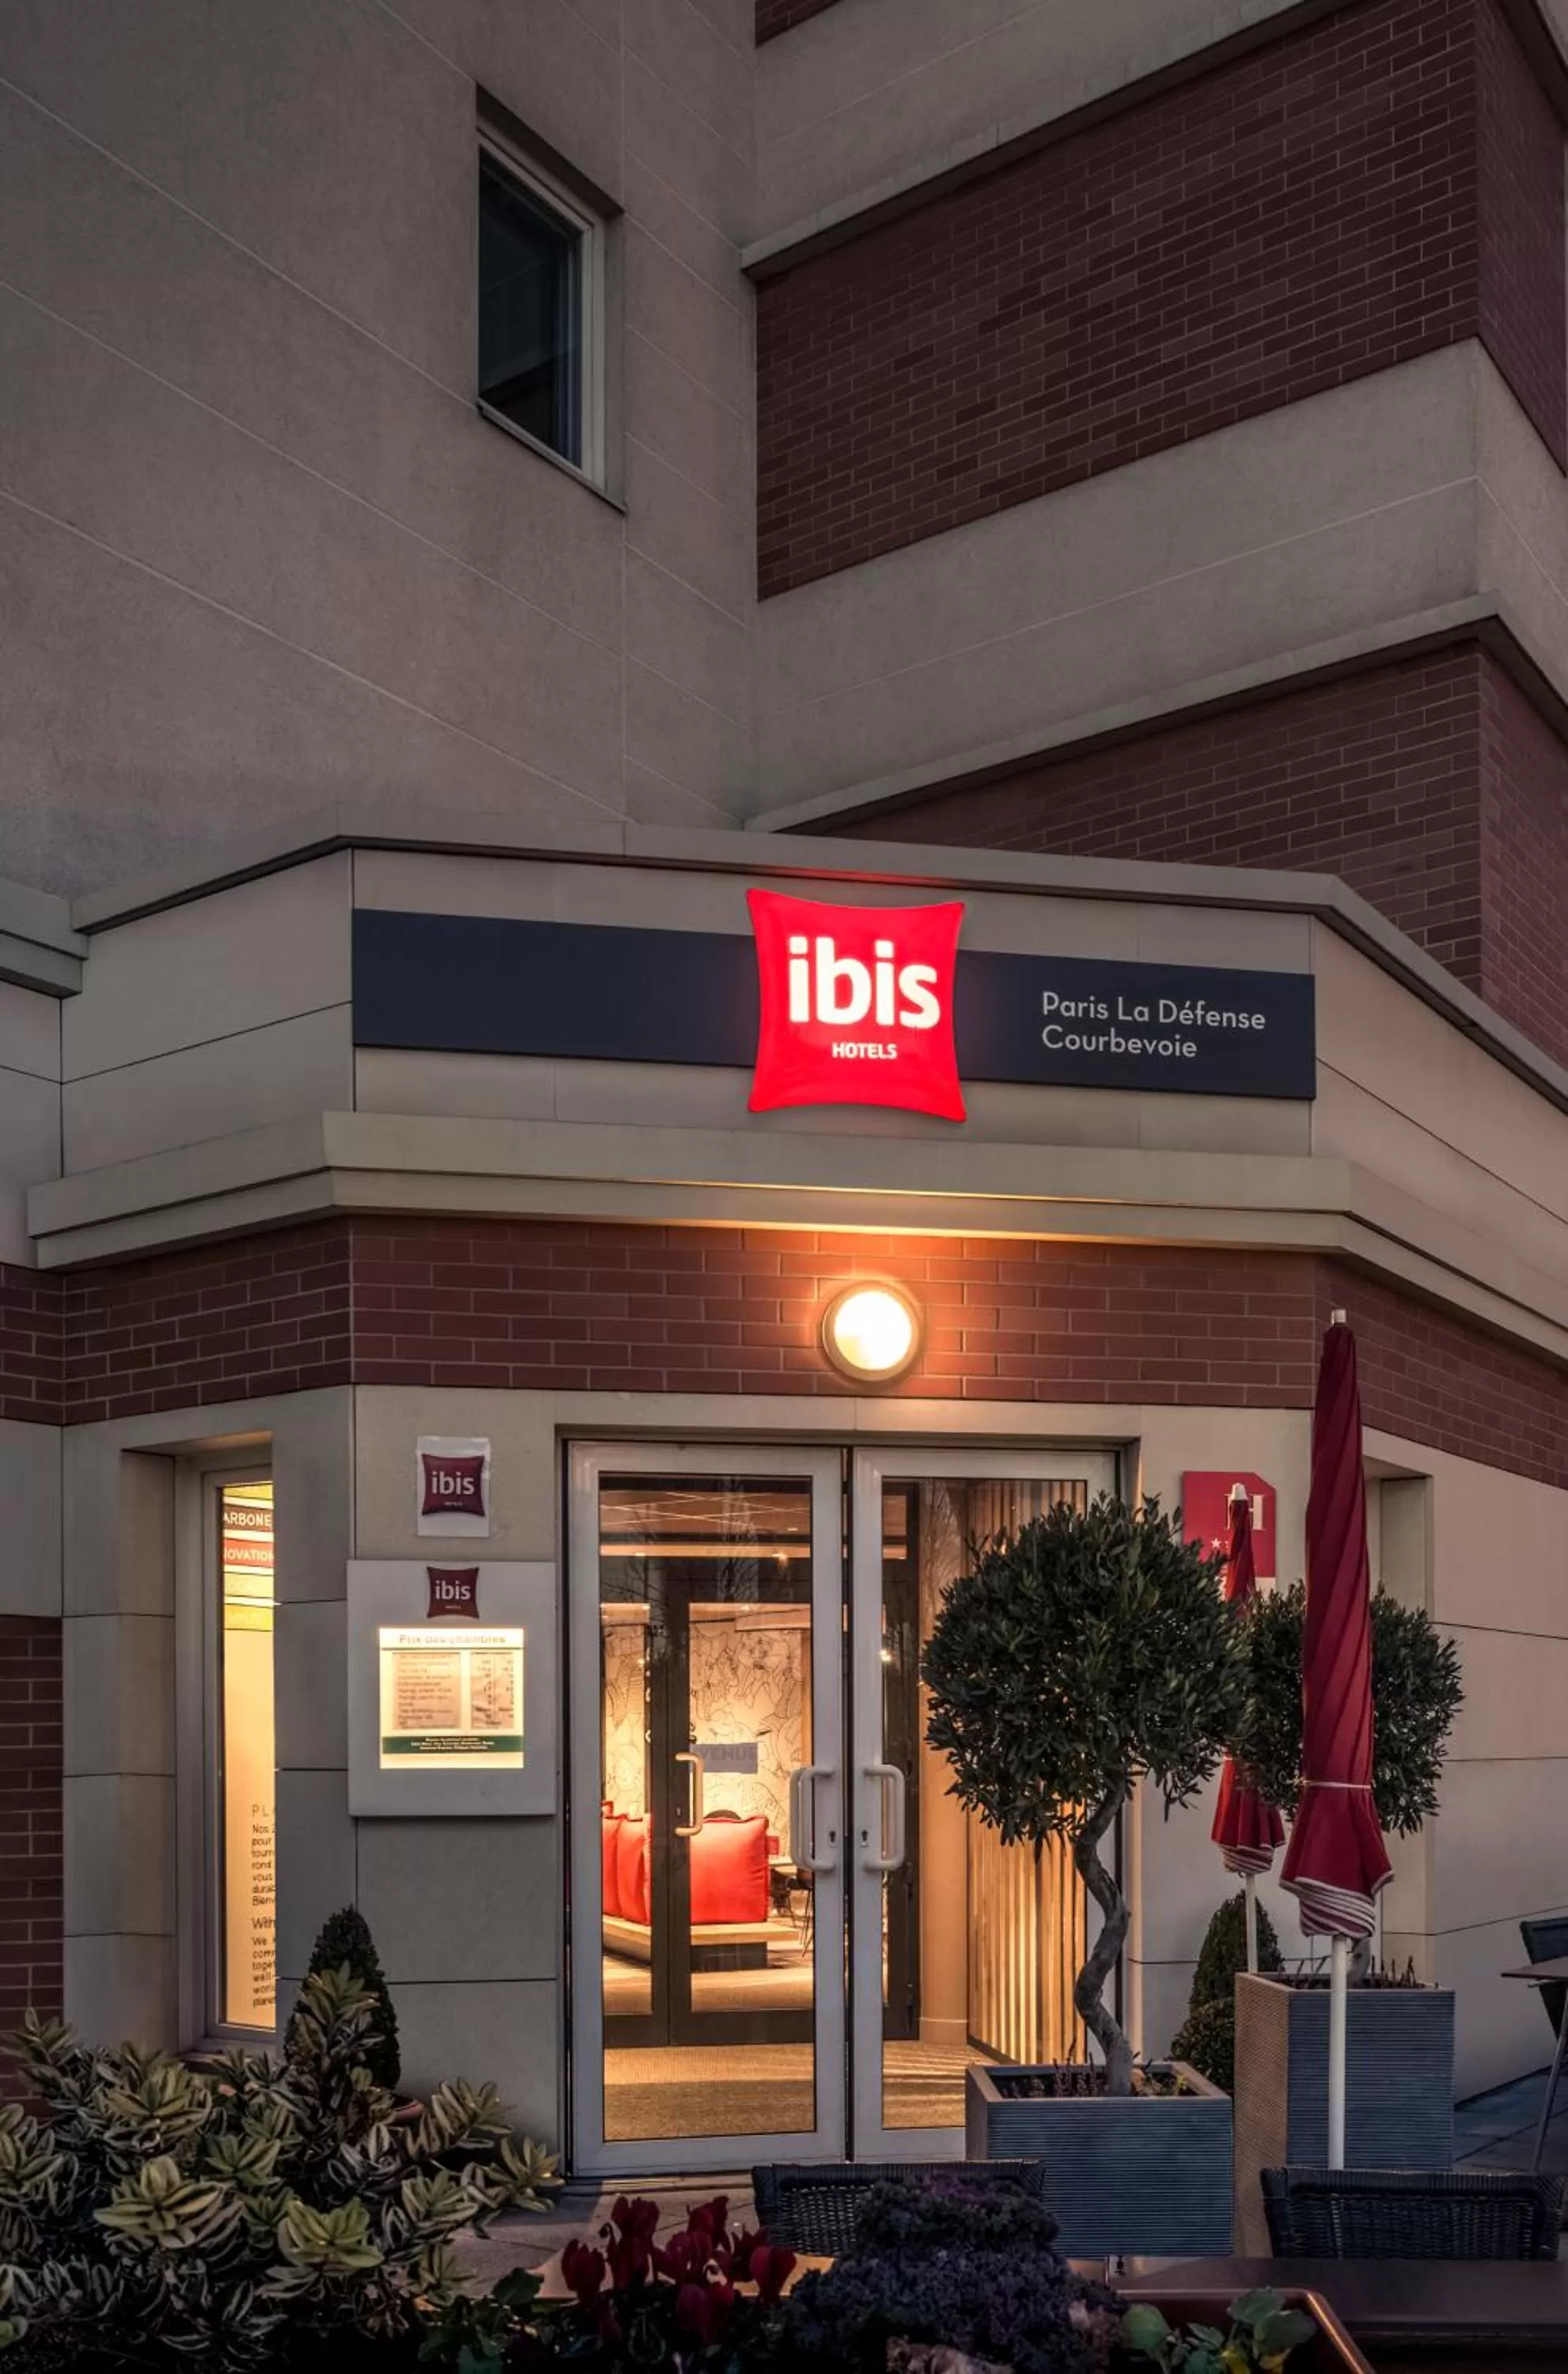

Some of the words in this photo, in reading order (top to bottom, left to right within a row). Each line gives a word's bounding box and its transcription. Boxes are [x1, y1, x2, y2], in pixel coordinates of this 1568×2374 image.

[789, 935, 941, 1030] ibis
[1042, 991, 1109, 1020] Paris
[1117, 995, 1149, 1022] La
[1158, 999, 1267, 1030] Défense
[832, 1042, 898, 1060] HOTELS
[1041, 1024, 1198, 1058] Courbevoie
[431, 1470, 475, 1495] ibis
[435, 1579, 472, 1600] ibis
